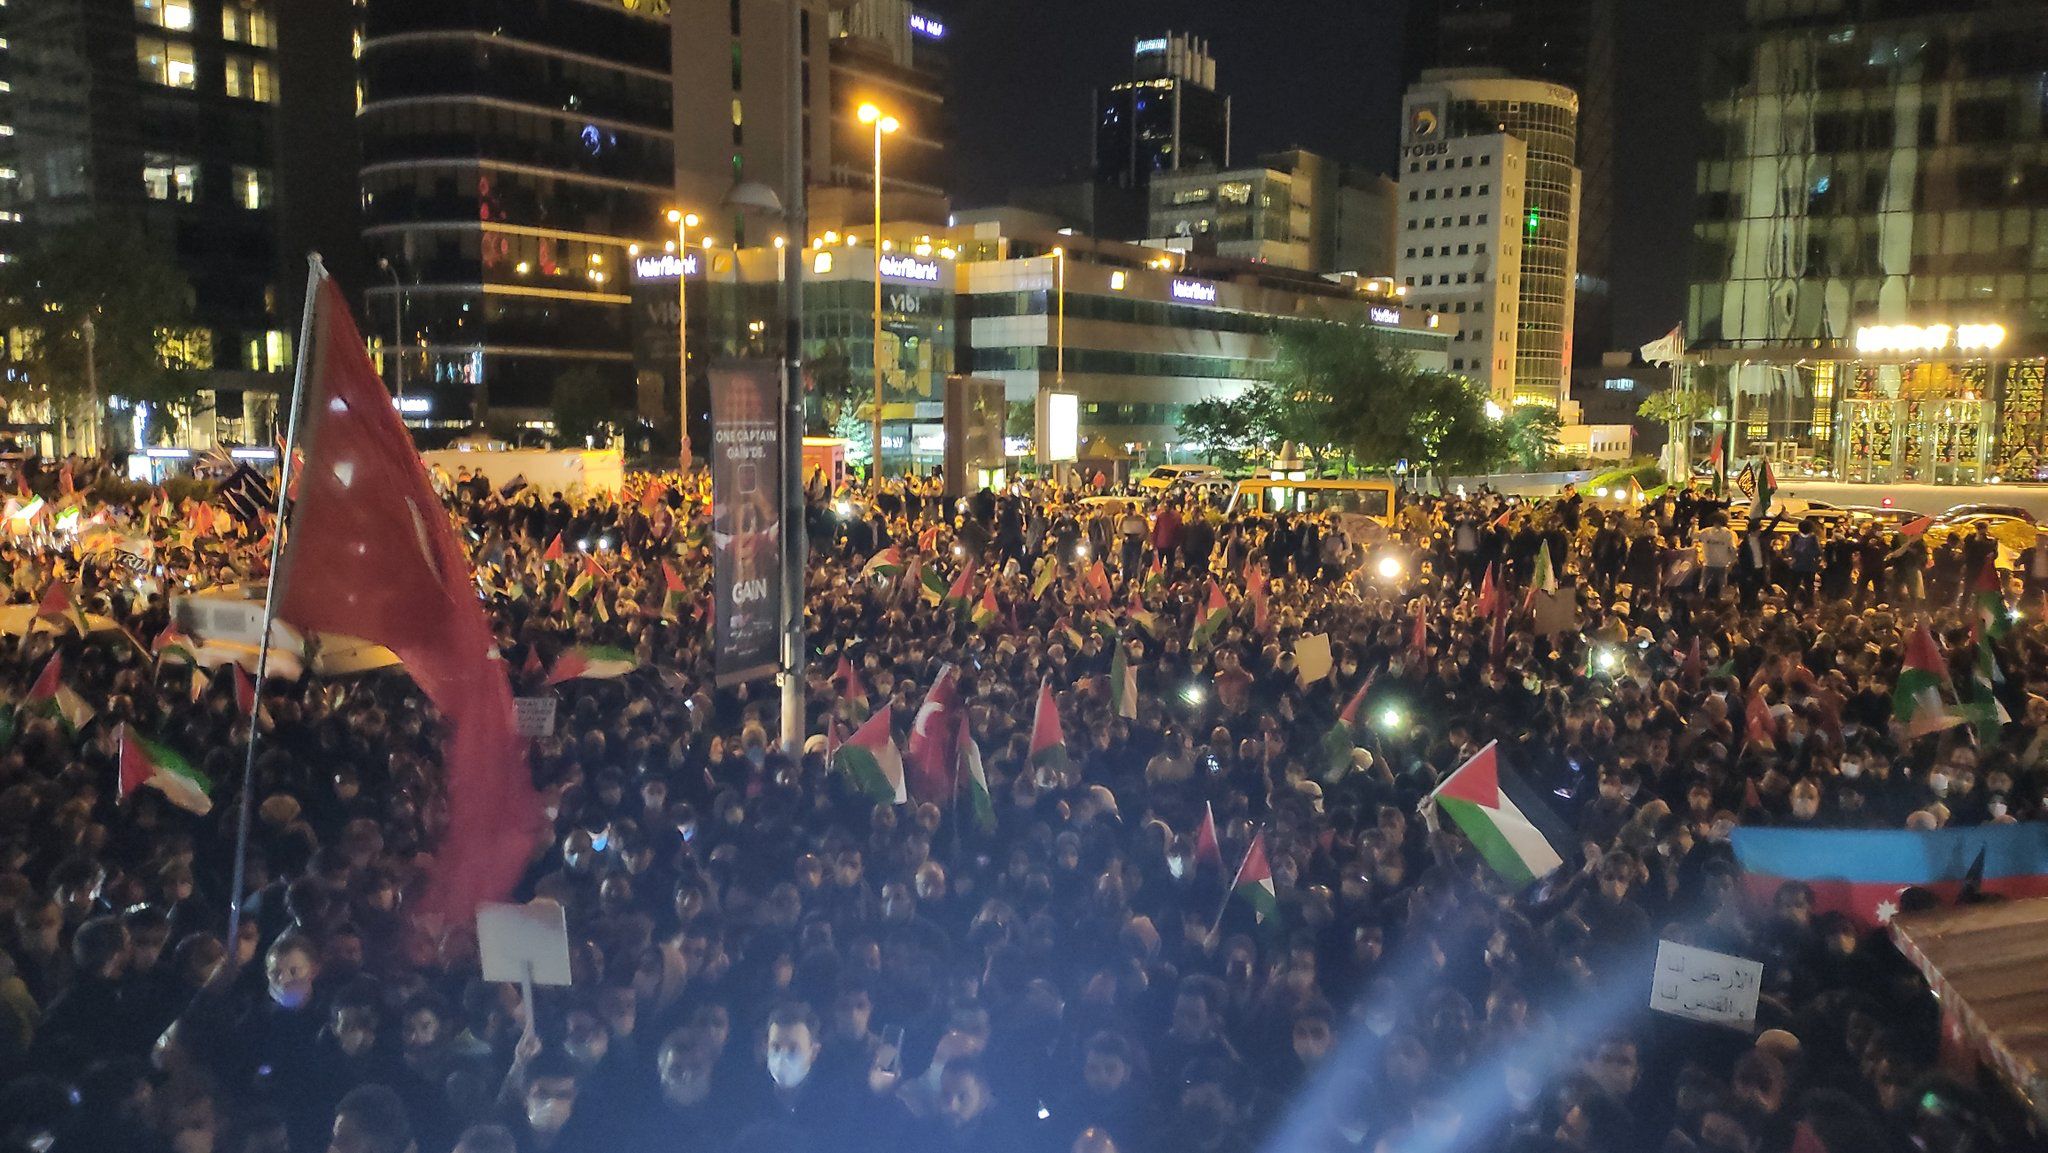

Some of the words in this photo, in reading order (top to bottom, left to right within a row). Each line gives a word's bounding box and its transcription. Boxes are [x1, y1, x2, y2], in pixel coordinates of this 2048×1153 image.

[1402, 142, 1449, 158] TOBB
[716, 429, 735, 443] ONE
[737, 429, 777, 442] CAPTAIN
